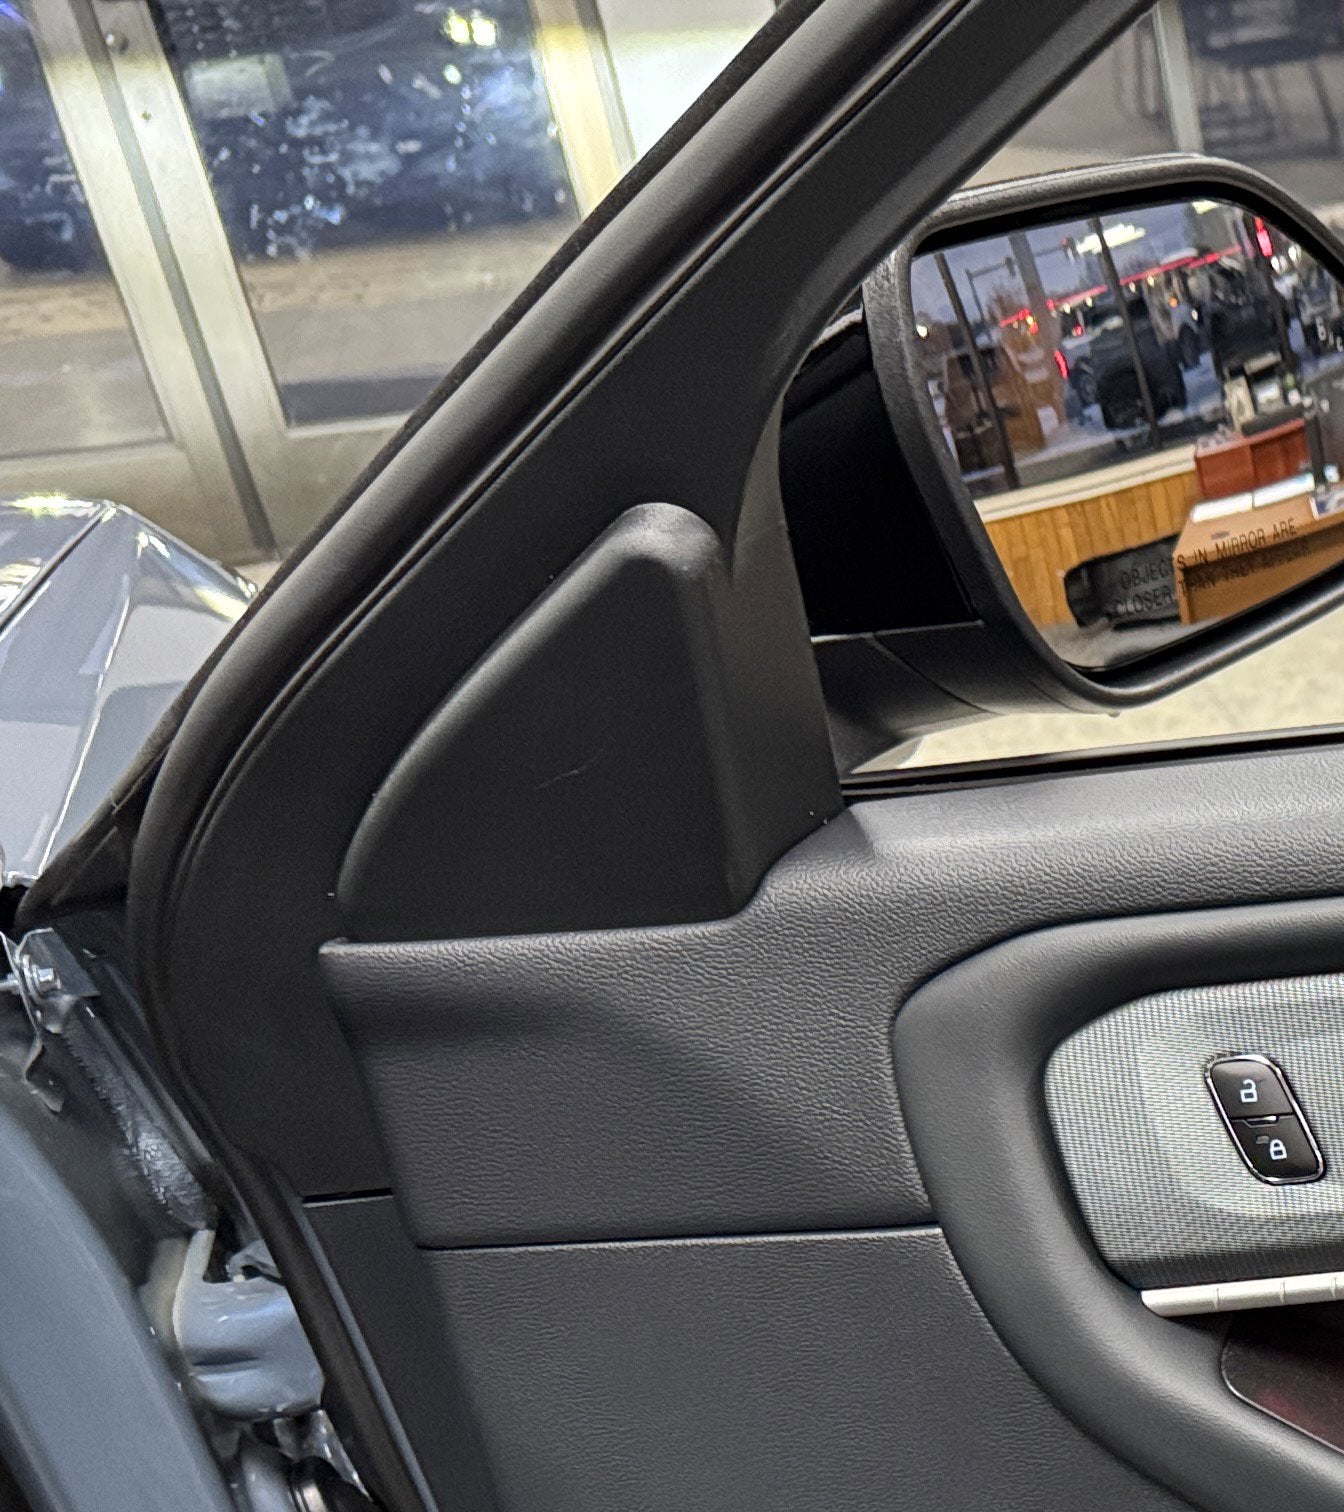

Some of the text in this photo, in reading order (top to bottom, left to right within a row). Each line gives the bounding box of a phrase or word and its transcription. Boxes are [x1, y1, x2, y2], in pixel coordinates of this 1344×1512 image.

[1119, 518, 1298, 590] OBJECTS IN MIRROR ARE
[1114, 586, 1173, 616] CLOSER
